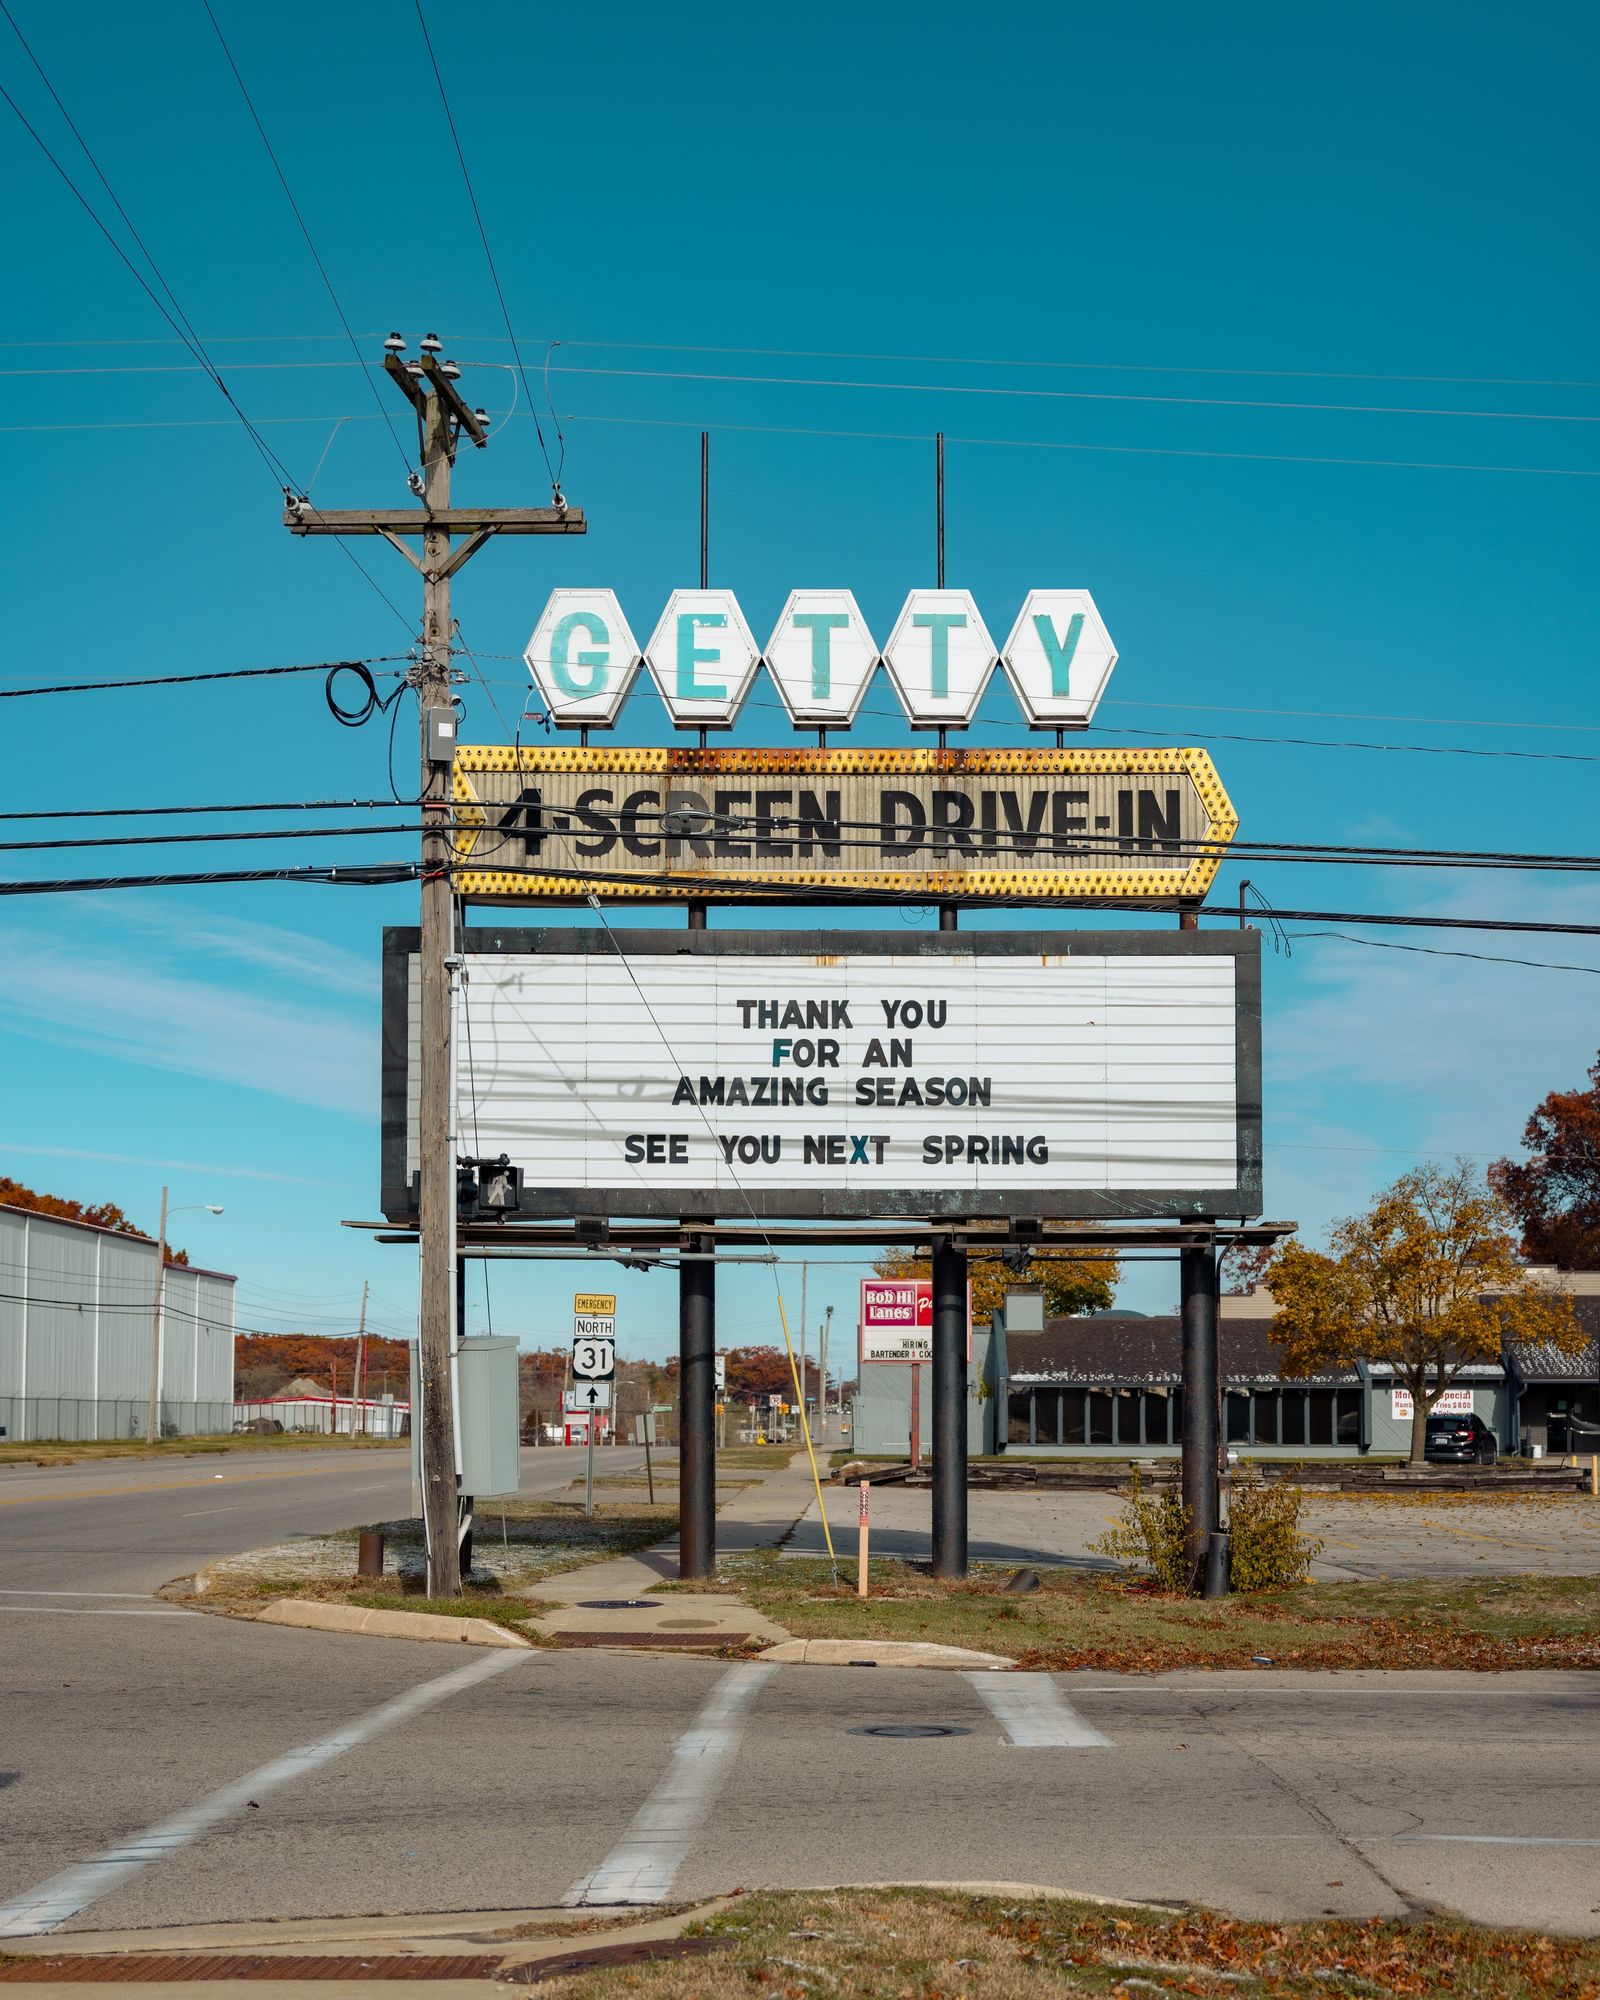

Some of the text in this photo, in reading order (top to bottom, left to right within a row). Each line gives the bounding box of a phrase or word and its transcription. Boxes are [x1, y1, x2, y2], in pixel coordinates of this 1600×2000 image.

[549, 611, 1086, 700] GETTY
[498, 788, 1181, 859] 4-SCREEN DRIVE-IN
[737, 999, 947, 1029] THANK YOU
[772, 1038, 913, 1068] FOR AN
[671, 1076, 991, 1107] AMAZING SEASON
[624, 1134, 1049, 1165] SEE YOU NEXT SPRING
[578, 1298, 613, 1310] EMERGENCY
[866, 1290, 914, 1304] Bob Hi
[870, 1305, 912, 1319] Lanes
[581, 1347, 606, 1370] 31
[903, 1341, 928, 1349] HIRING
